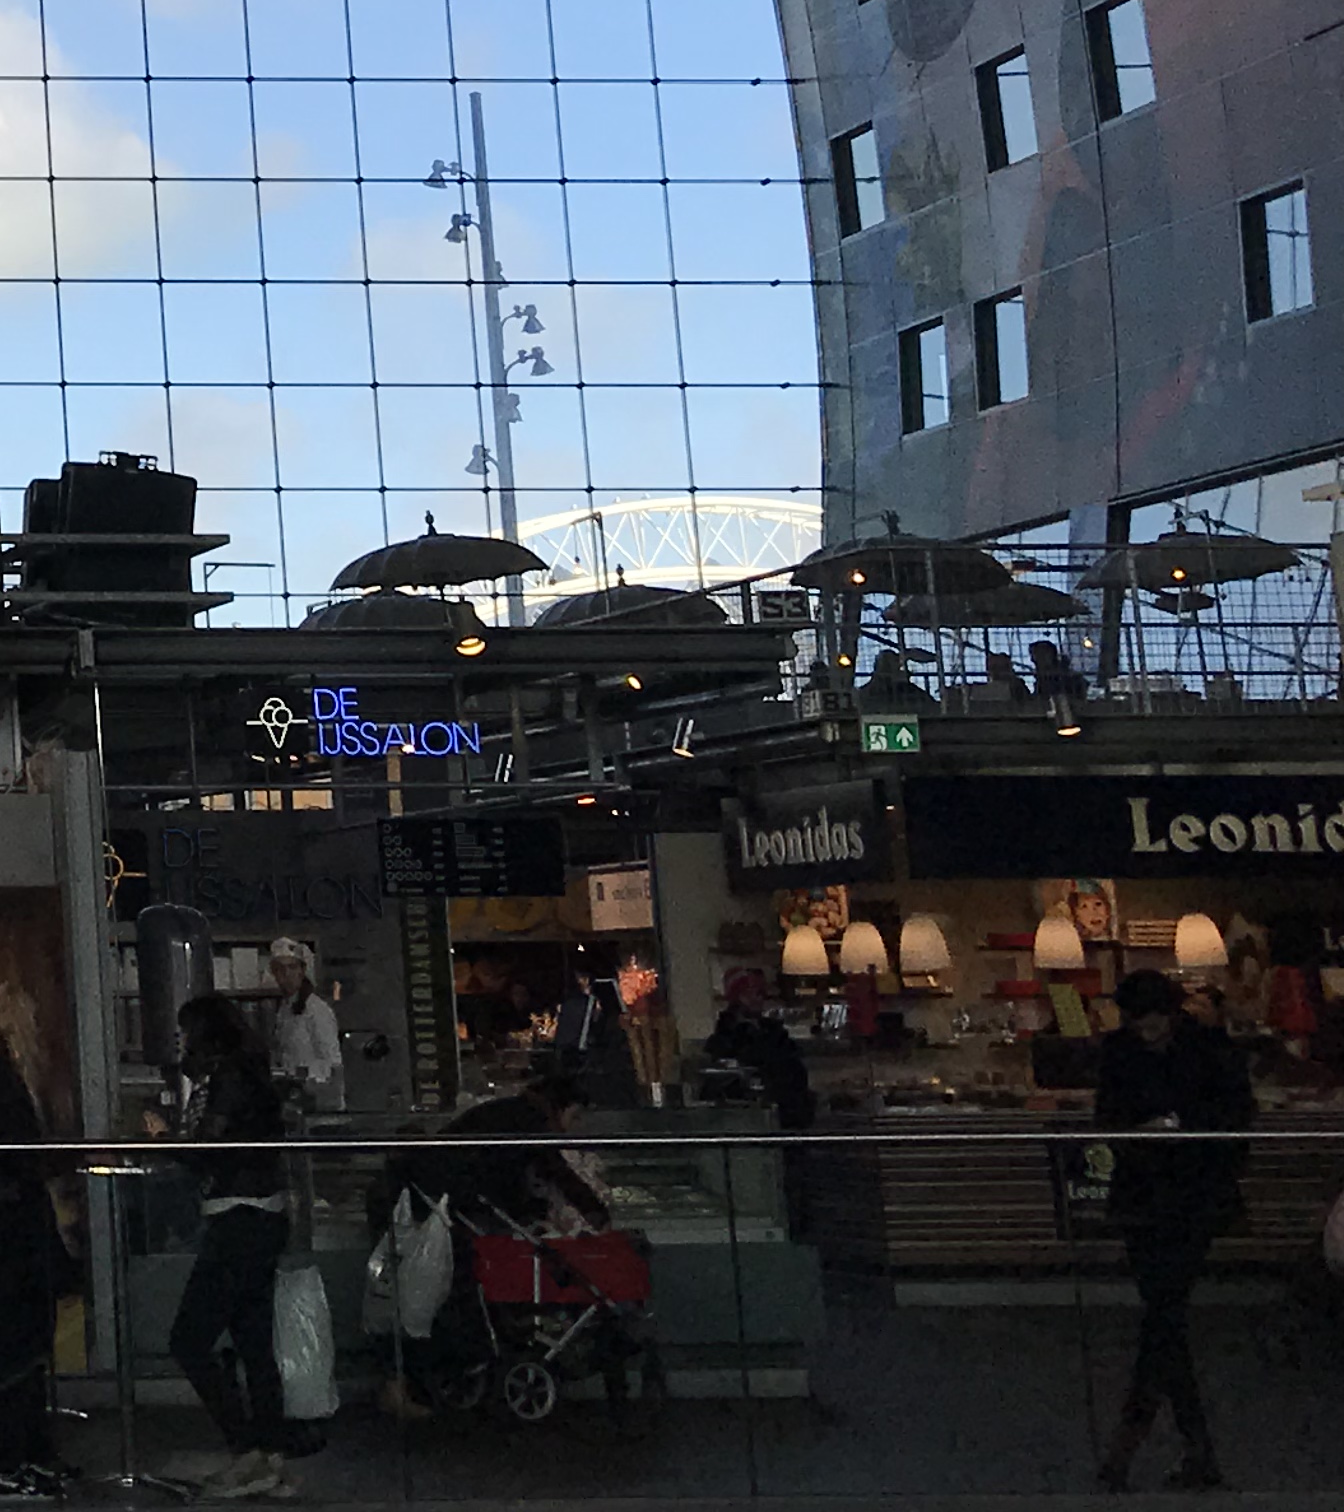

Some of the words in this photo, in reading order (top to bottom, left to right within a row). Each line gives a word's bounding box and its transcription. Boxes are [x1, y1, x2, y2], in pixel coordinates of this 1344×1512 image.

[313, 687, 361, 721] DE
[318, 721, 482, 756] IJSSALON
[163, 827, 219, 868] DE
[737, 805, 865, 868] Leonidas
